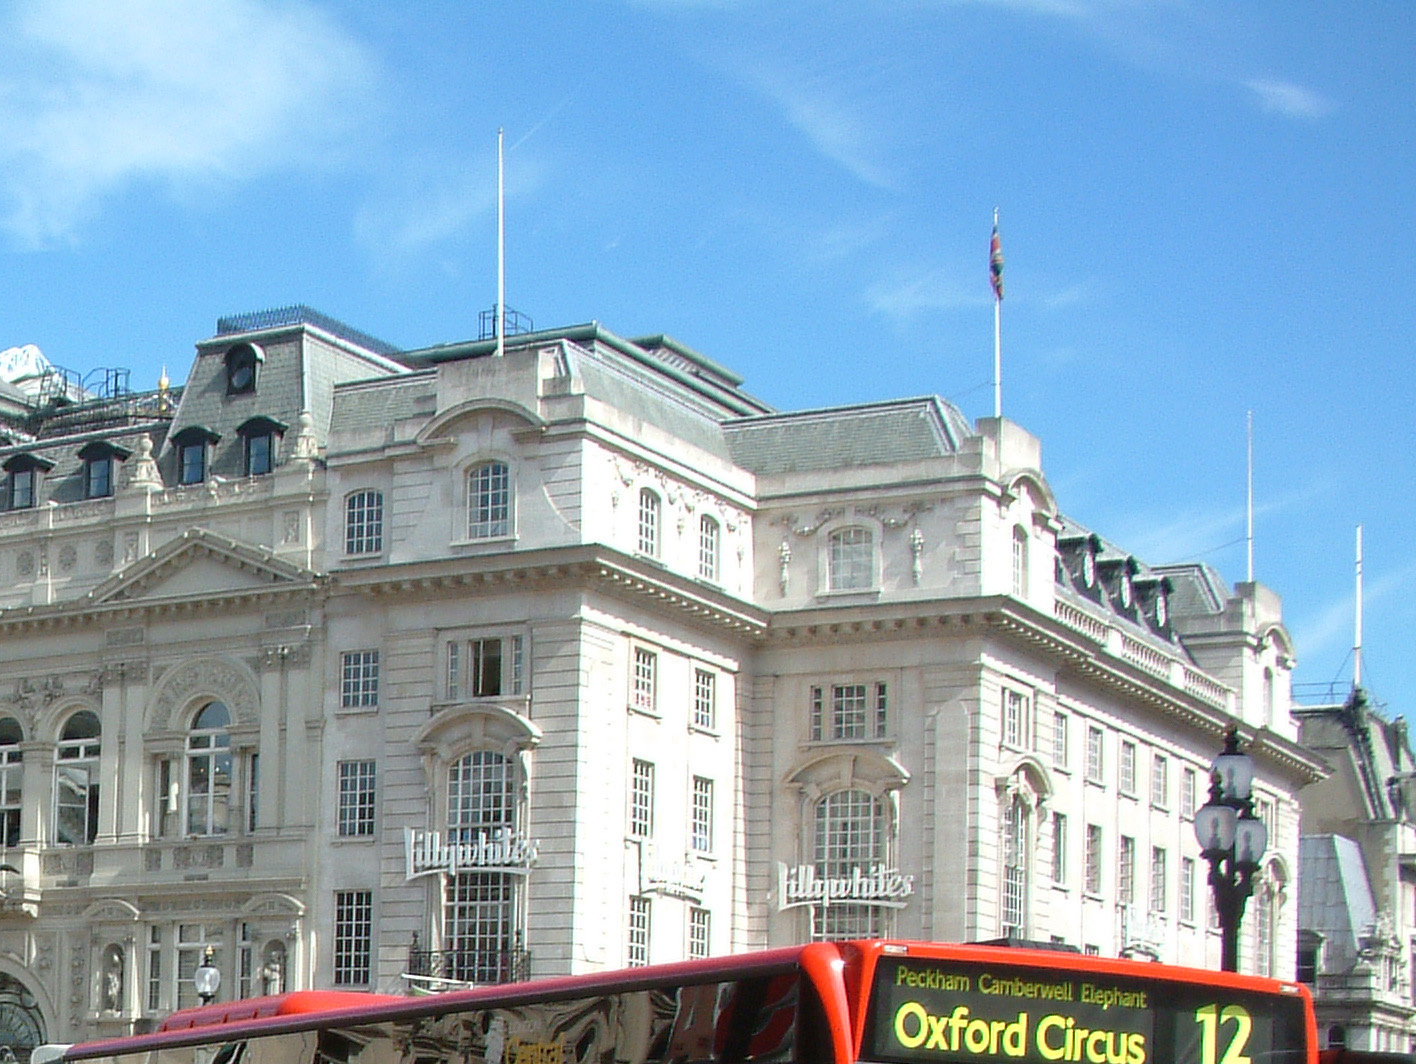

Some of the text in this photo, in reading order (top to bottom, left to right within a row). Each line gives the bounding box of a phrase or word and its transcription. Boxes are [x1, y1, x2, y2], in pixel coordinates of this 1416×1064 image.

[404, 826, 540, 880] Lillywhites
[777, 861, 915, 911] Lillywhites
[896, 966, 1147, 1010] Peckham Camberwell Elephant
[894, 1001, 1029, 1057] Oxford
